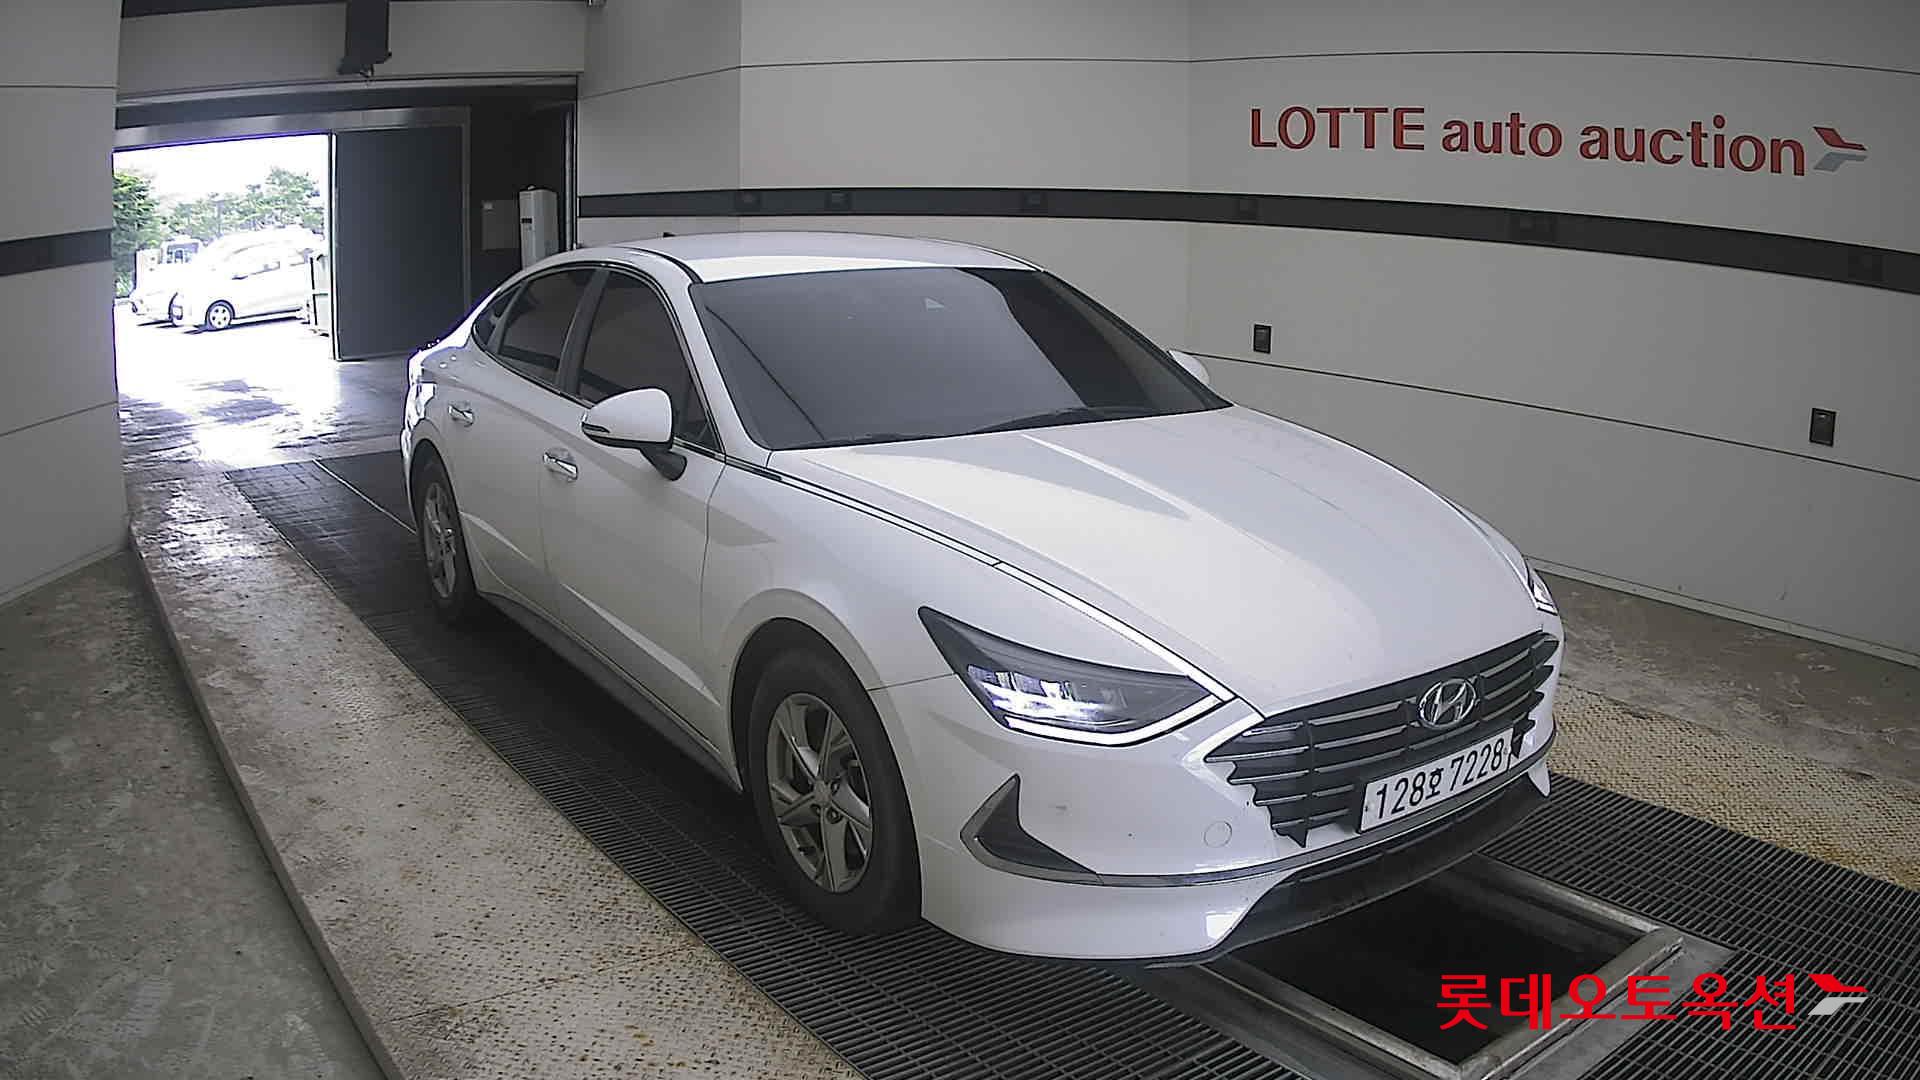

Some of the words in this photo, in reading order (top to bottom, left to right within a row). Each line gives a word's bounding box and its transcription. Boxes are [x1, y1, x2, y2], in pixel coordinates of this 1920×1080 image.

[1250, 107, 1426, 151] LOTTE
[1441, 112, 1563, 158] auto
[1578, 114, 1805, 176] auction
[1376, 768, 1444, 819] 128호
[1449, 738, 1505, 792] 7228
